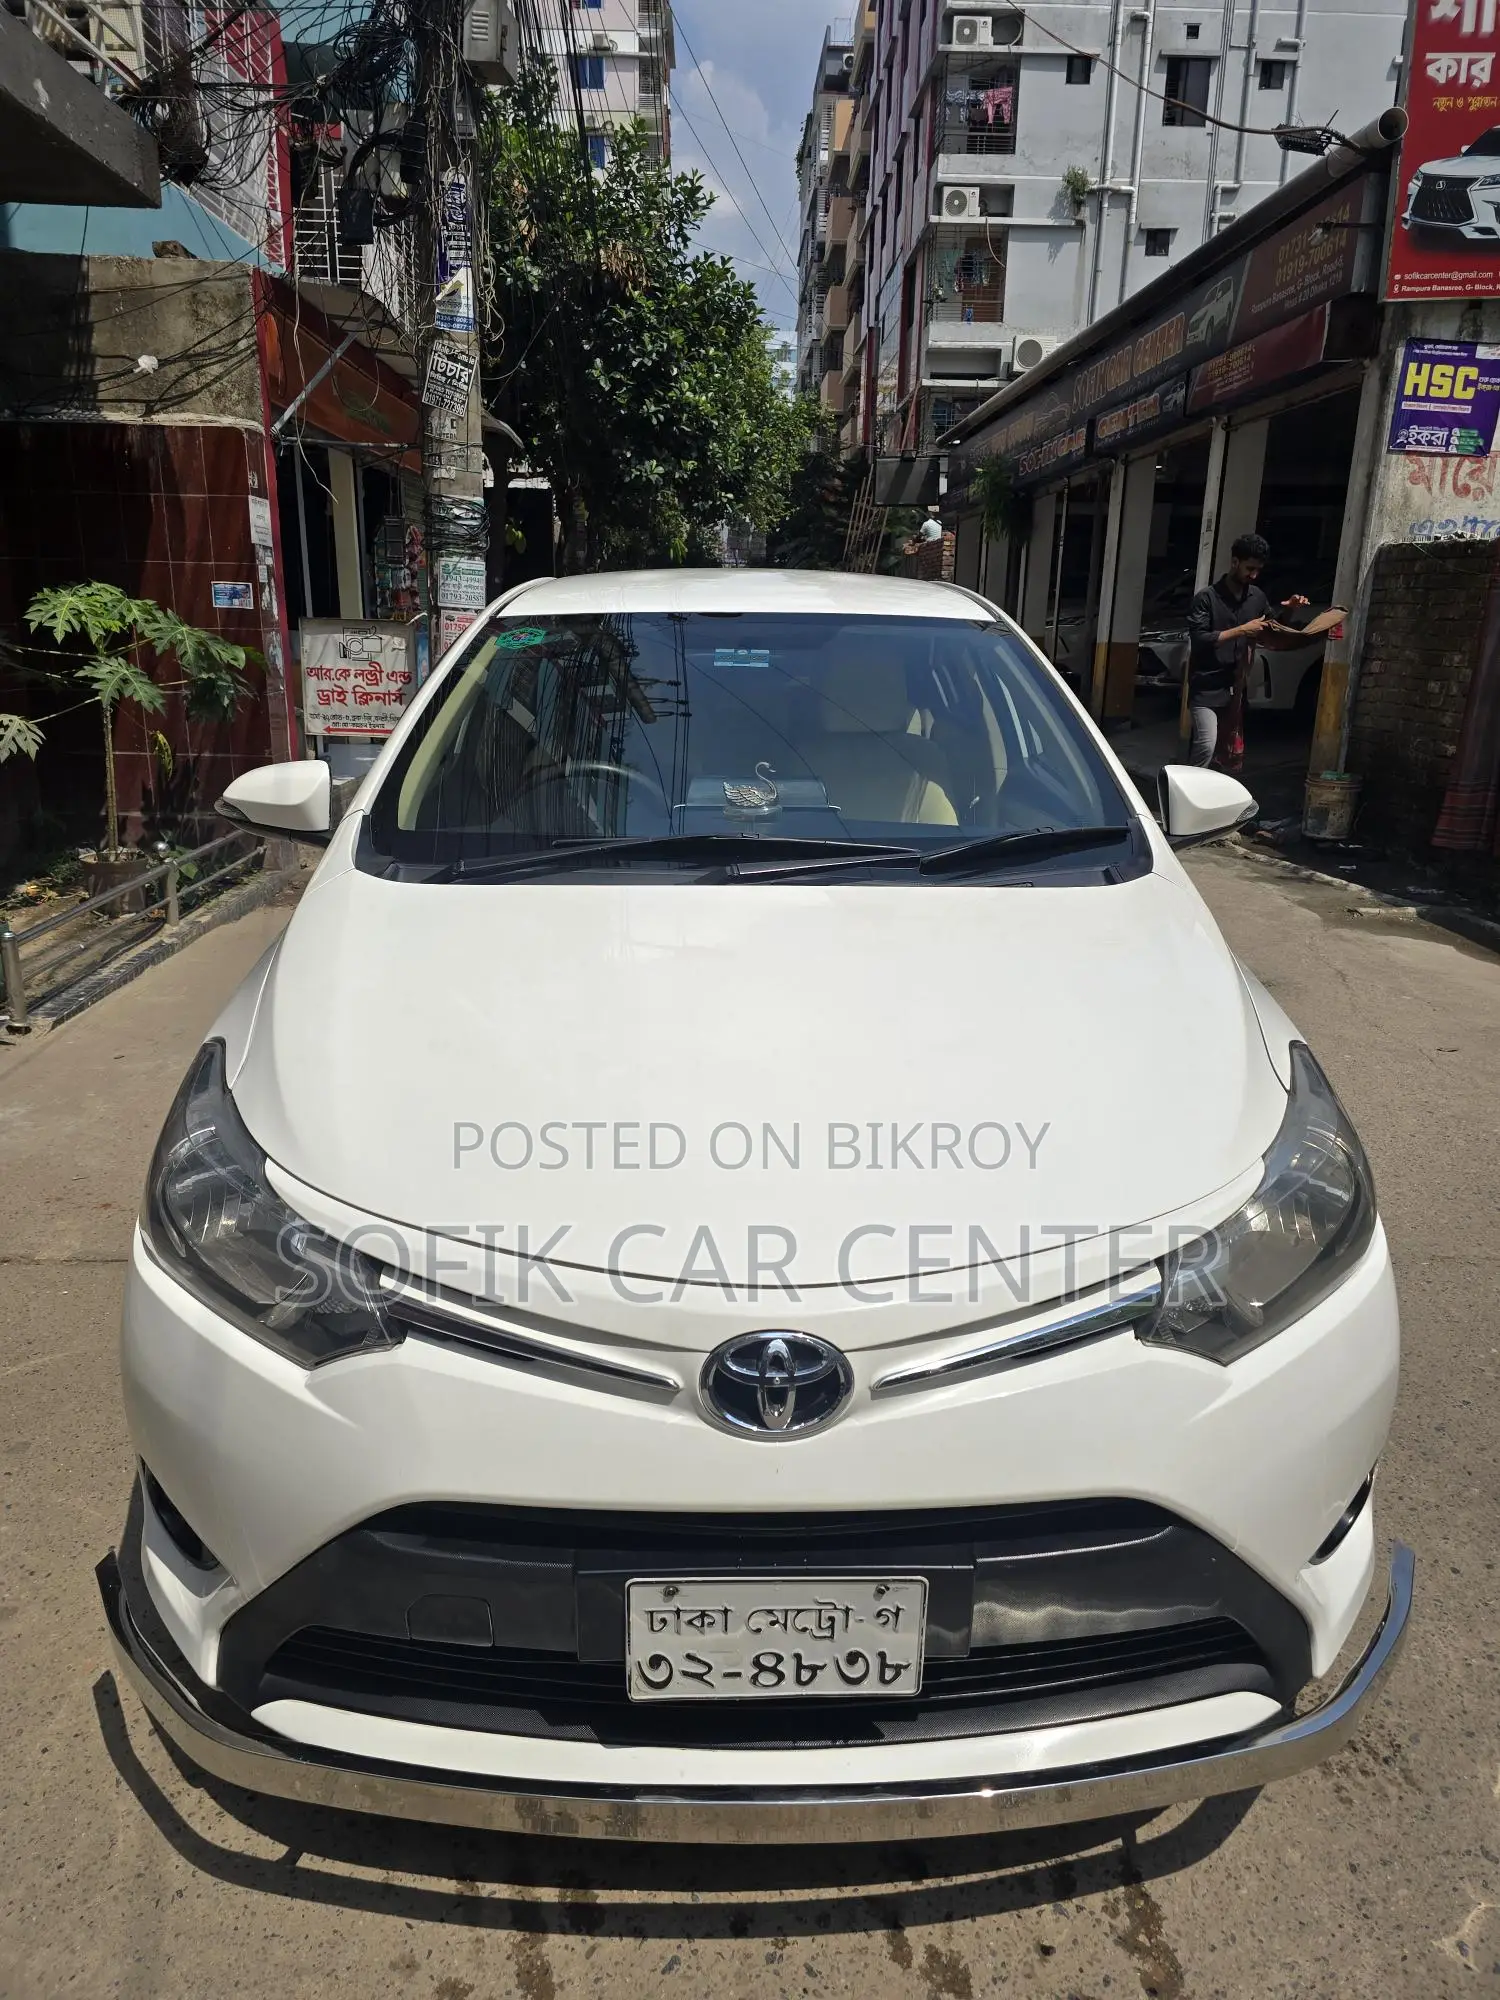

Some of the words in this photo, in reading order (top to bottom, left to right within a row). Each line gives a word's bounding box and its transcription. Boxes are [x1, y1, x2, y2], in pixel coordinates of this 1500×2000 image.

[1425, 52, 1496, 88] কার
[1404, 271, 1493, 280] sofikcarcenter@gmail.com
[1432, 284, 1463, 292] Banasree,
[432, 352, 473, 383] টিচার
[1404, 362, 1478, 400] HSC
[317, 684, 348, 706] ড্রাই
[645, 1604, 733, 1635] ঢাকা
[637, 1651, 911, 1689] ৩২-৪৮৩৮
